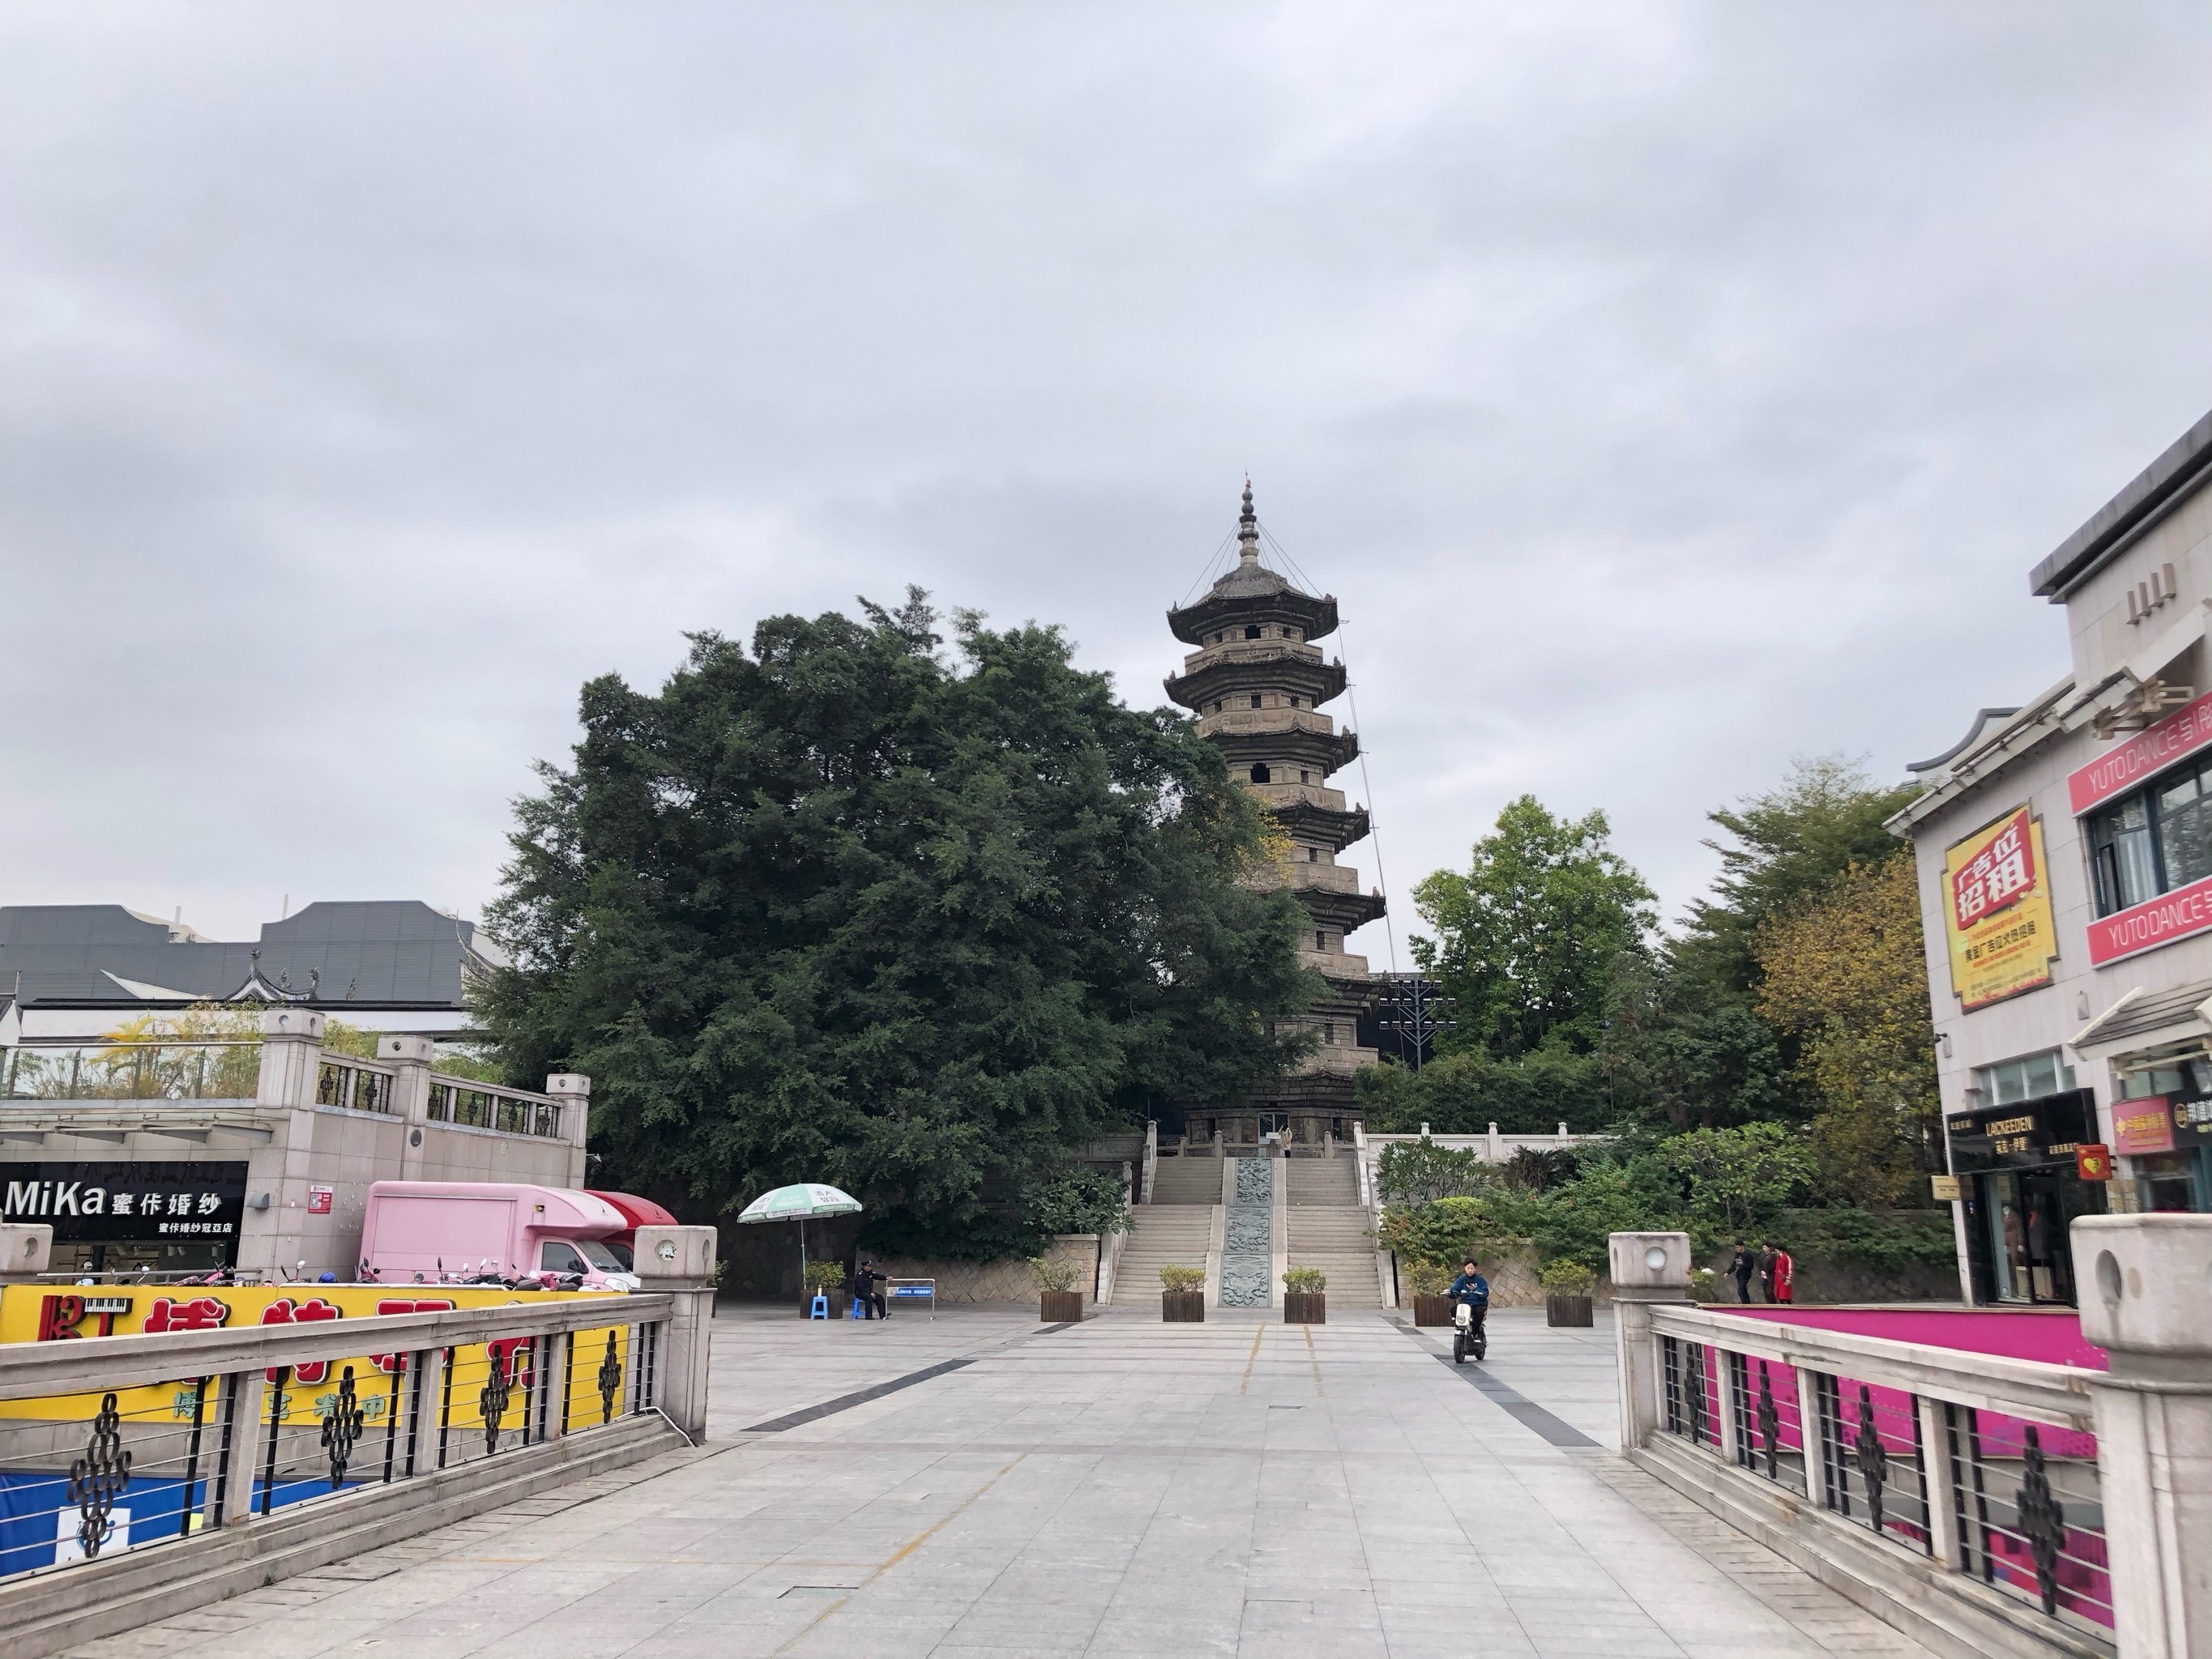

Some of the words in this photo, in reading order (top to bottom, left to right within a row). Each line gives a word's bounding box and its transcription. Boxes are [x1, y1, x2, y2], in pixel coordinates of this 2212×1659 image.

[1958, 822, 2022, 893] 广告位
[1958, 848, 2030, 922] 招租
[4, 1180, 107, 1216] MiKa
